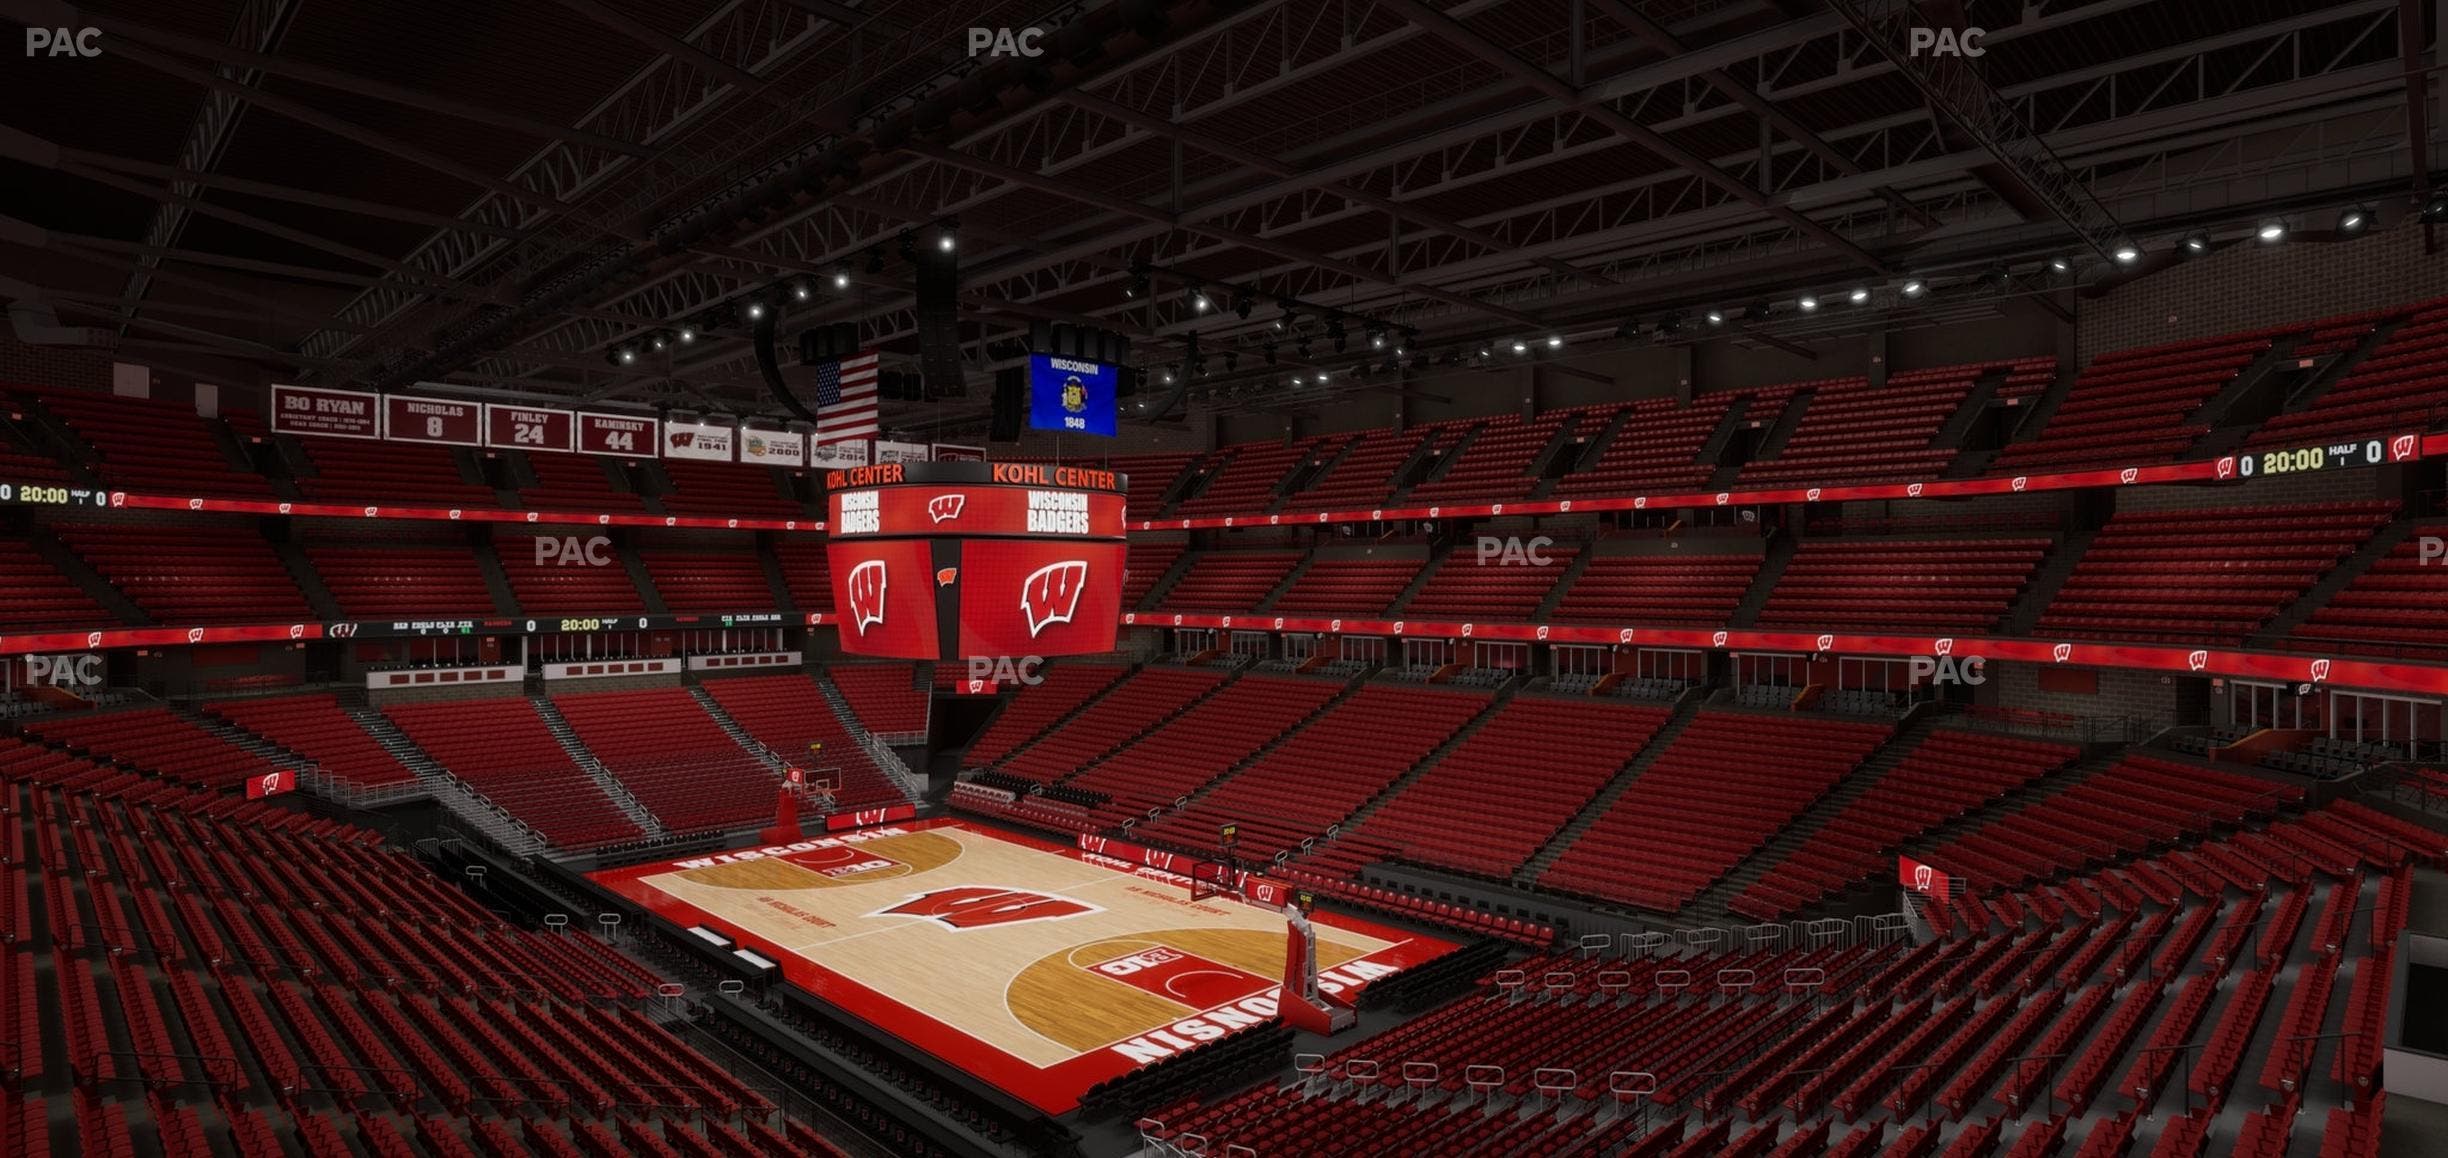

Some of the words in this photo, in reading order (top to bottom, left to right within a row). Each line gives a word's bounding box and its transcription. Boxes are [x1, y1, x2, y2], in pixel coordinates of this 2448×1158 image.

[1050, 357, 1099, 375] WISCONSIN
[284, 395, 310, 411] BO
[316, 398, 365, 415] RYAN
[407, 402, 464, 417] NICHOLAS
[427, 416, 443, 437] 8
[511, 411, 549, 424] FINLEY
[594, 418, 645, 432] KAMINSKY
[1064, 416, 1086, 429] 1848
[514, 423, 545, 445] 24
[604, 431, 634, 450] 44
[698, 442, 727, 452] 1941
[768, 447, 800, 457] 2000
[2240, 456, 2254, 477] 0
[2263, 447, 2324, 475] 20:00
[2329, 444, 2357, 457] HALF
[2366, 440, 2382, 463] 0
[826, 470, 848, 490] KOHL
[850, 463, 904, 488] CENTER
[993, 462, 1049, 485] KOHL
[1054, 467, 1117, 490] CENTER
[0, 484, 12, 500] 0
[20, 485, 68, 503] 20:00
[96, 491, 106, 506] 0
[1027, 490, 1089, 511] WISCONSIN
[1027, 509, 1090, 534] BADGERS
[526, 619, 537, 632] 0
[561, 618, 600, 632] 20:00
[638, 616, 649, 629] 0
[672, 826, 908, 870] WISCONSIN
[1110, 958, 1402, 1065] WISONSIN
